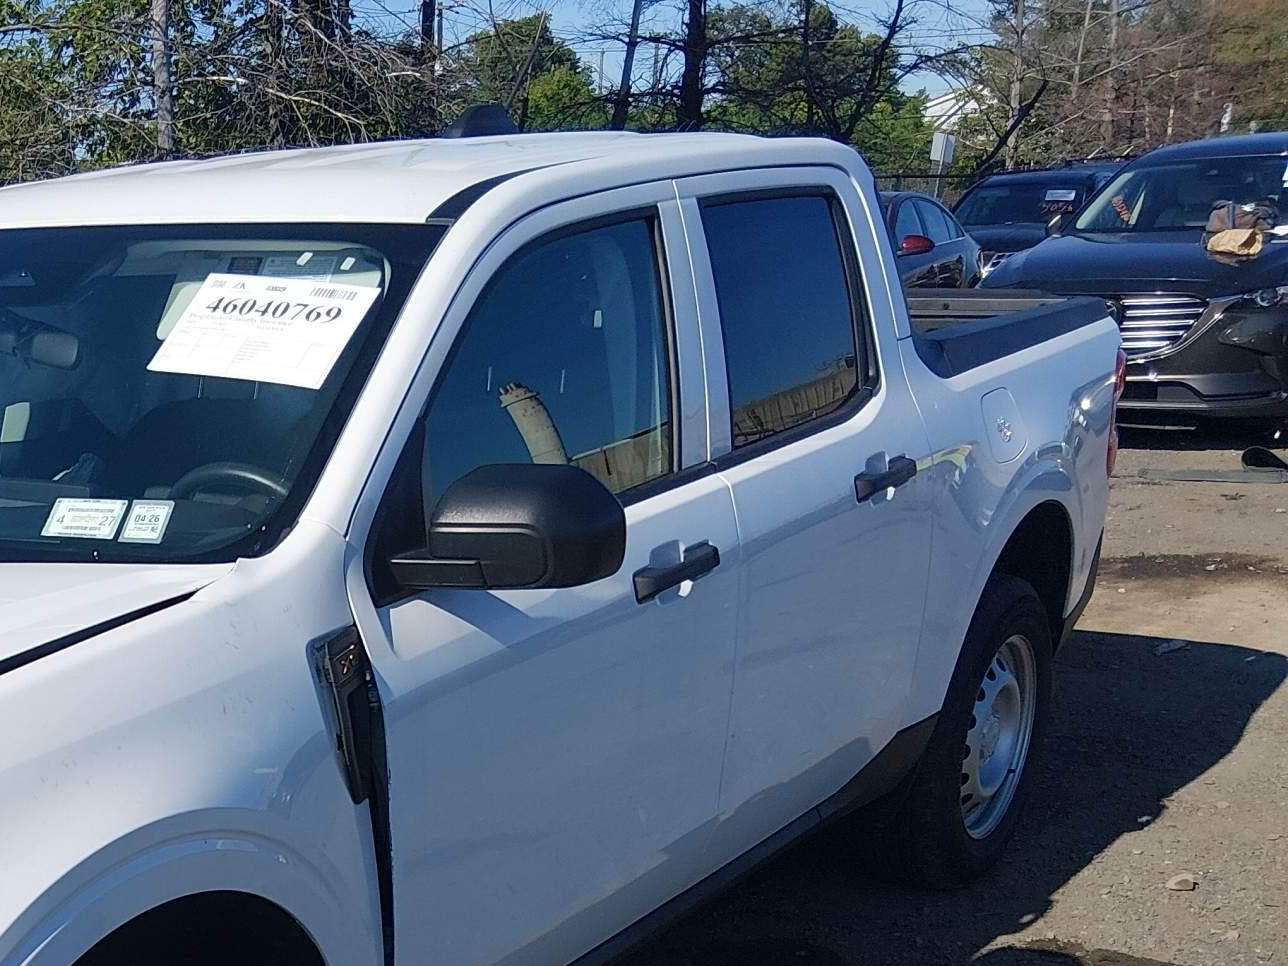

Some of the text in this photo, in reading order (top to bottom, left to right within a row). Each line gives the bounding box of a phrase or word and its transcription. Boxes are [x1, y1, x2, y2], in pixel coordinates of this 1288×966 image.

[206, 295, 343, 324] 46040769
[56, 513, 66, 525] 4
[98, 515, 117, 527] 27
